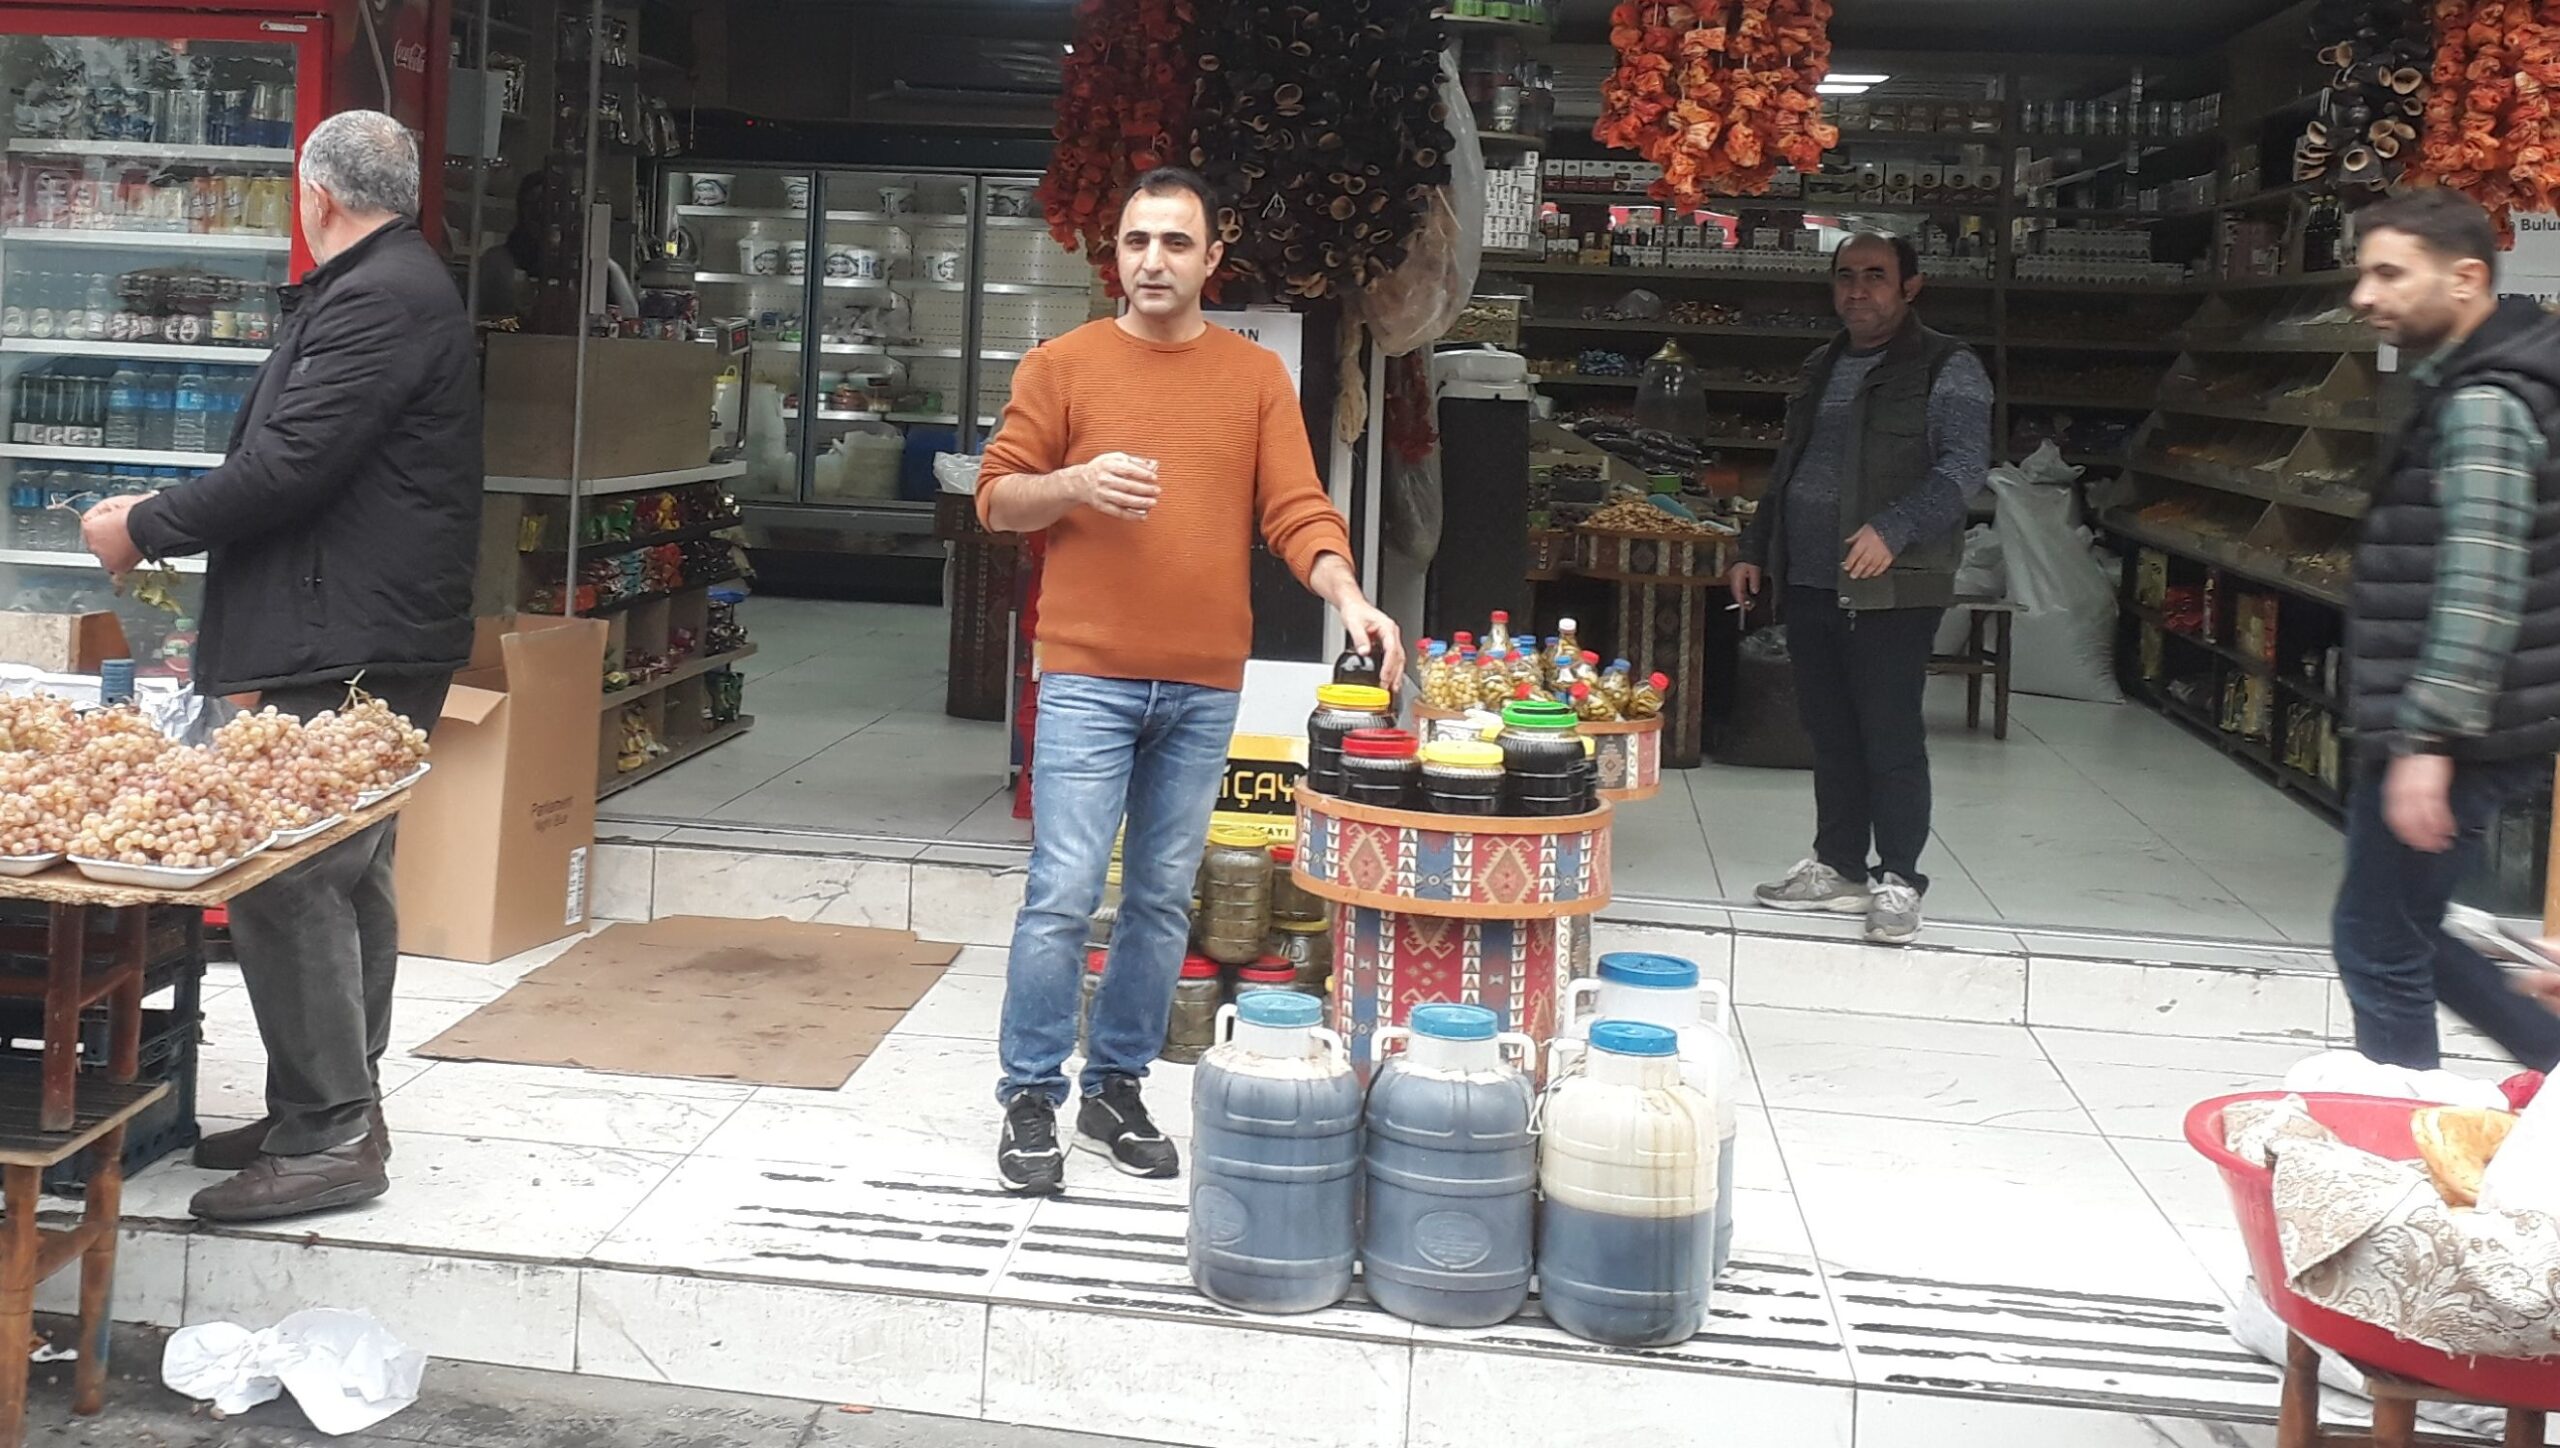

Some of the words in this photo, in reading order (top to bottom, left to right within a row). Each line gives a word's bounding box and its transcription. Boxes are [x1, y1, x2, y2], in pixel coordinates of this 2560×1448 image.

[2521, 218, 2560, 231] Bulu
[1229, 328, 1260, 342] AN
[1258, 826, 1289, 837] AYI
